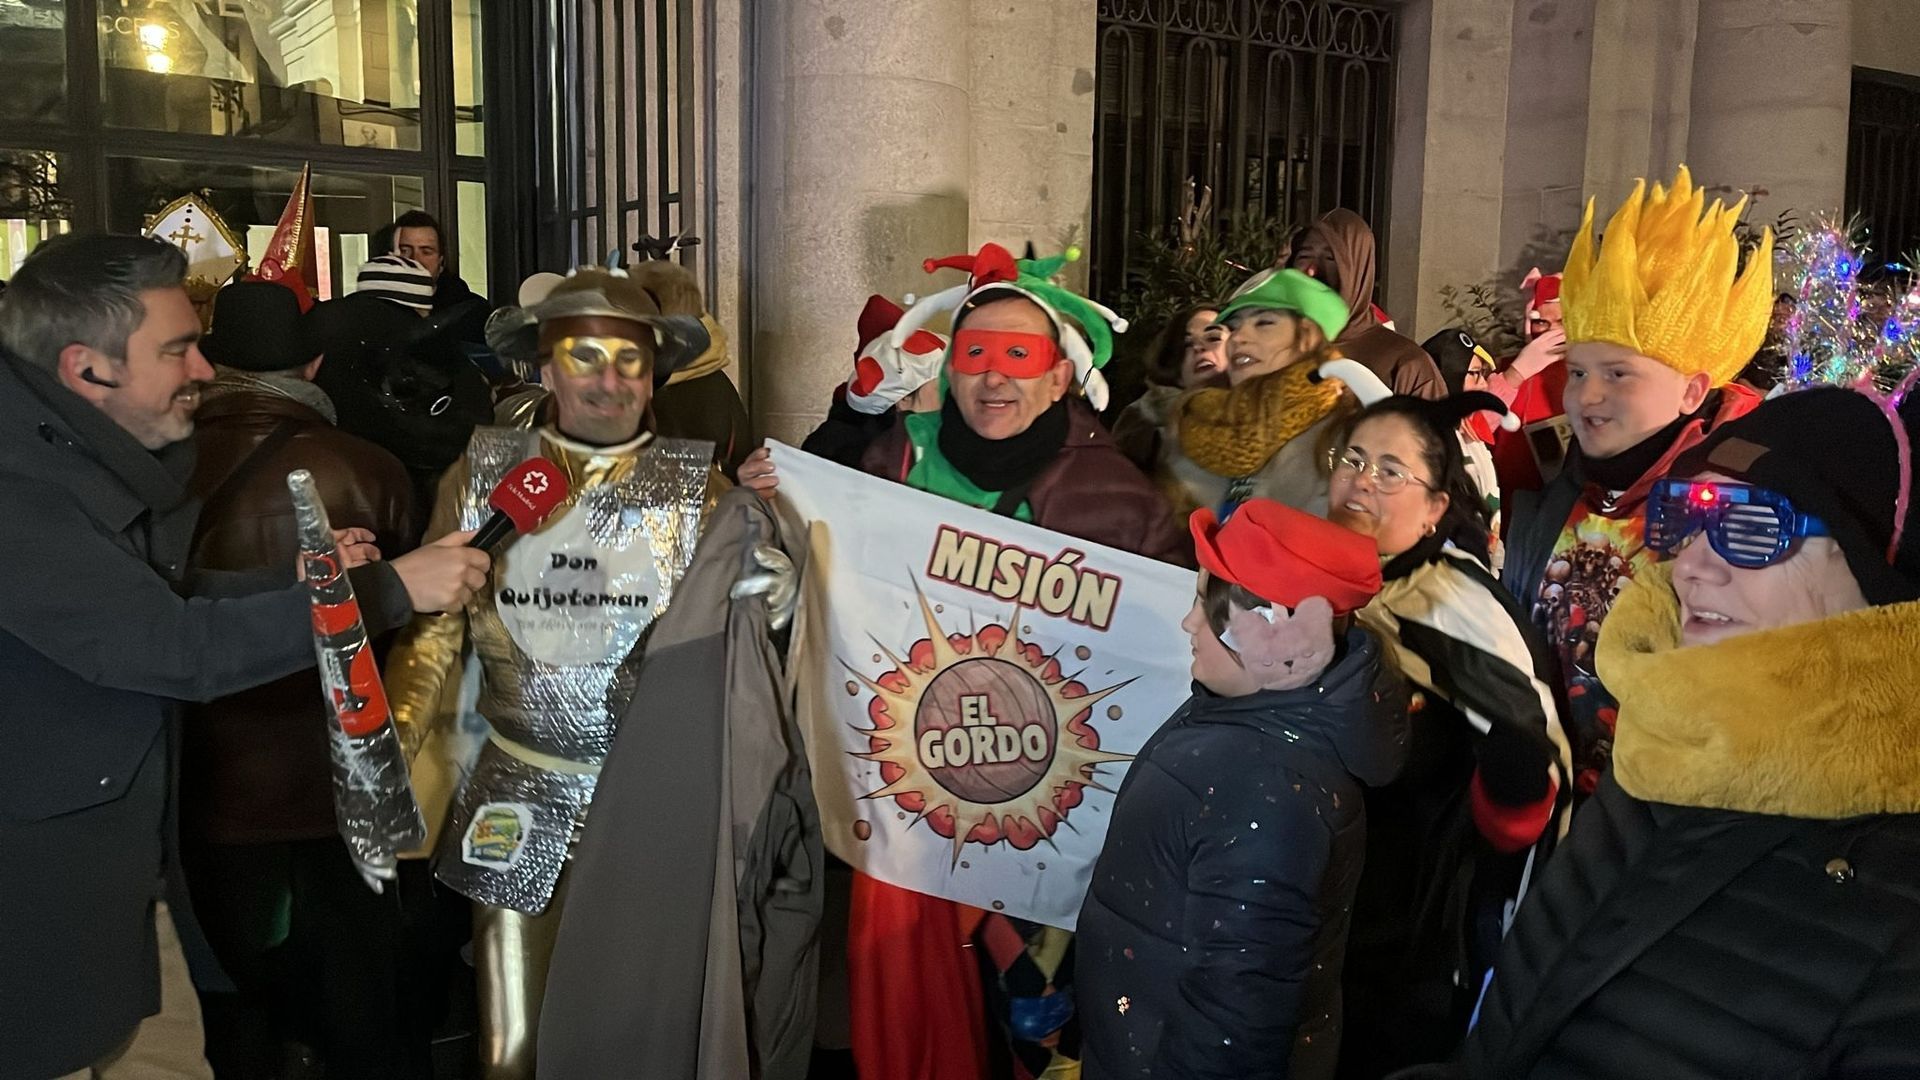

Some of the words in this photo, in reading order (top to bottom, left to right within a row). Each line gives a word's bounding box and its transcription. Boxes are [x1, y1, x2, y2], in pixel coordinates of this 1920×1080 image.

[551, 552, 598, 570] Don
[929, 526, 1120, 630] MISIÓN
[500, 588, 649, 609] Quijoteman
[961, 695, 997, 727] EL
[918, 724, 1048, 768] GORDO
